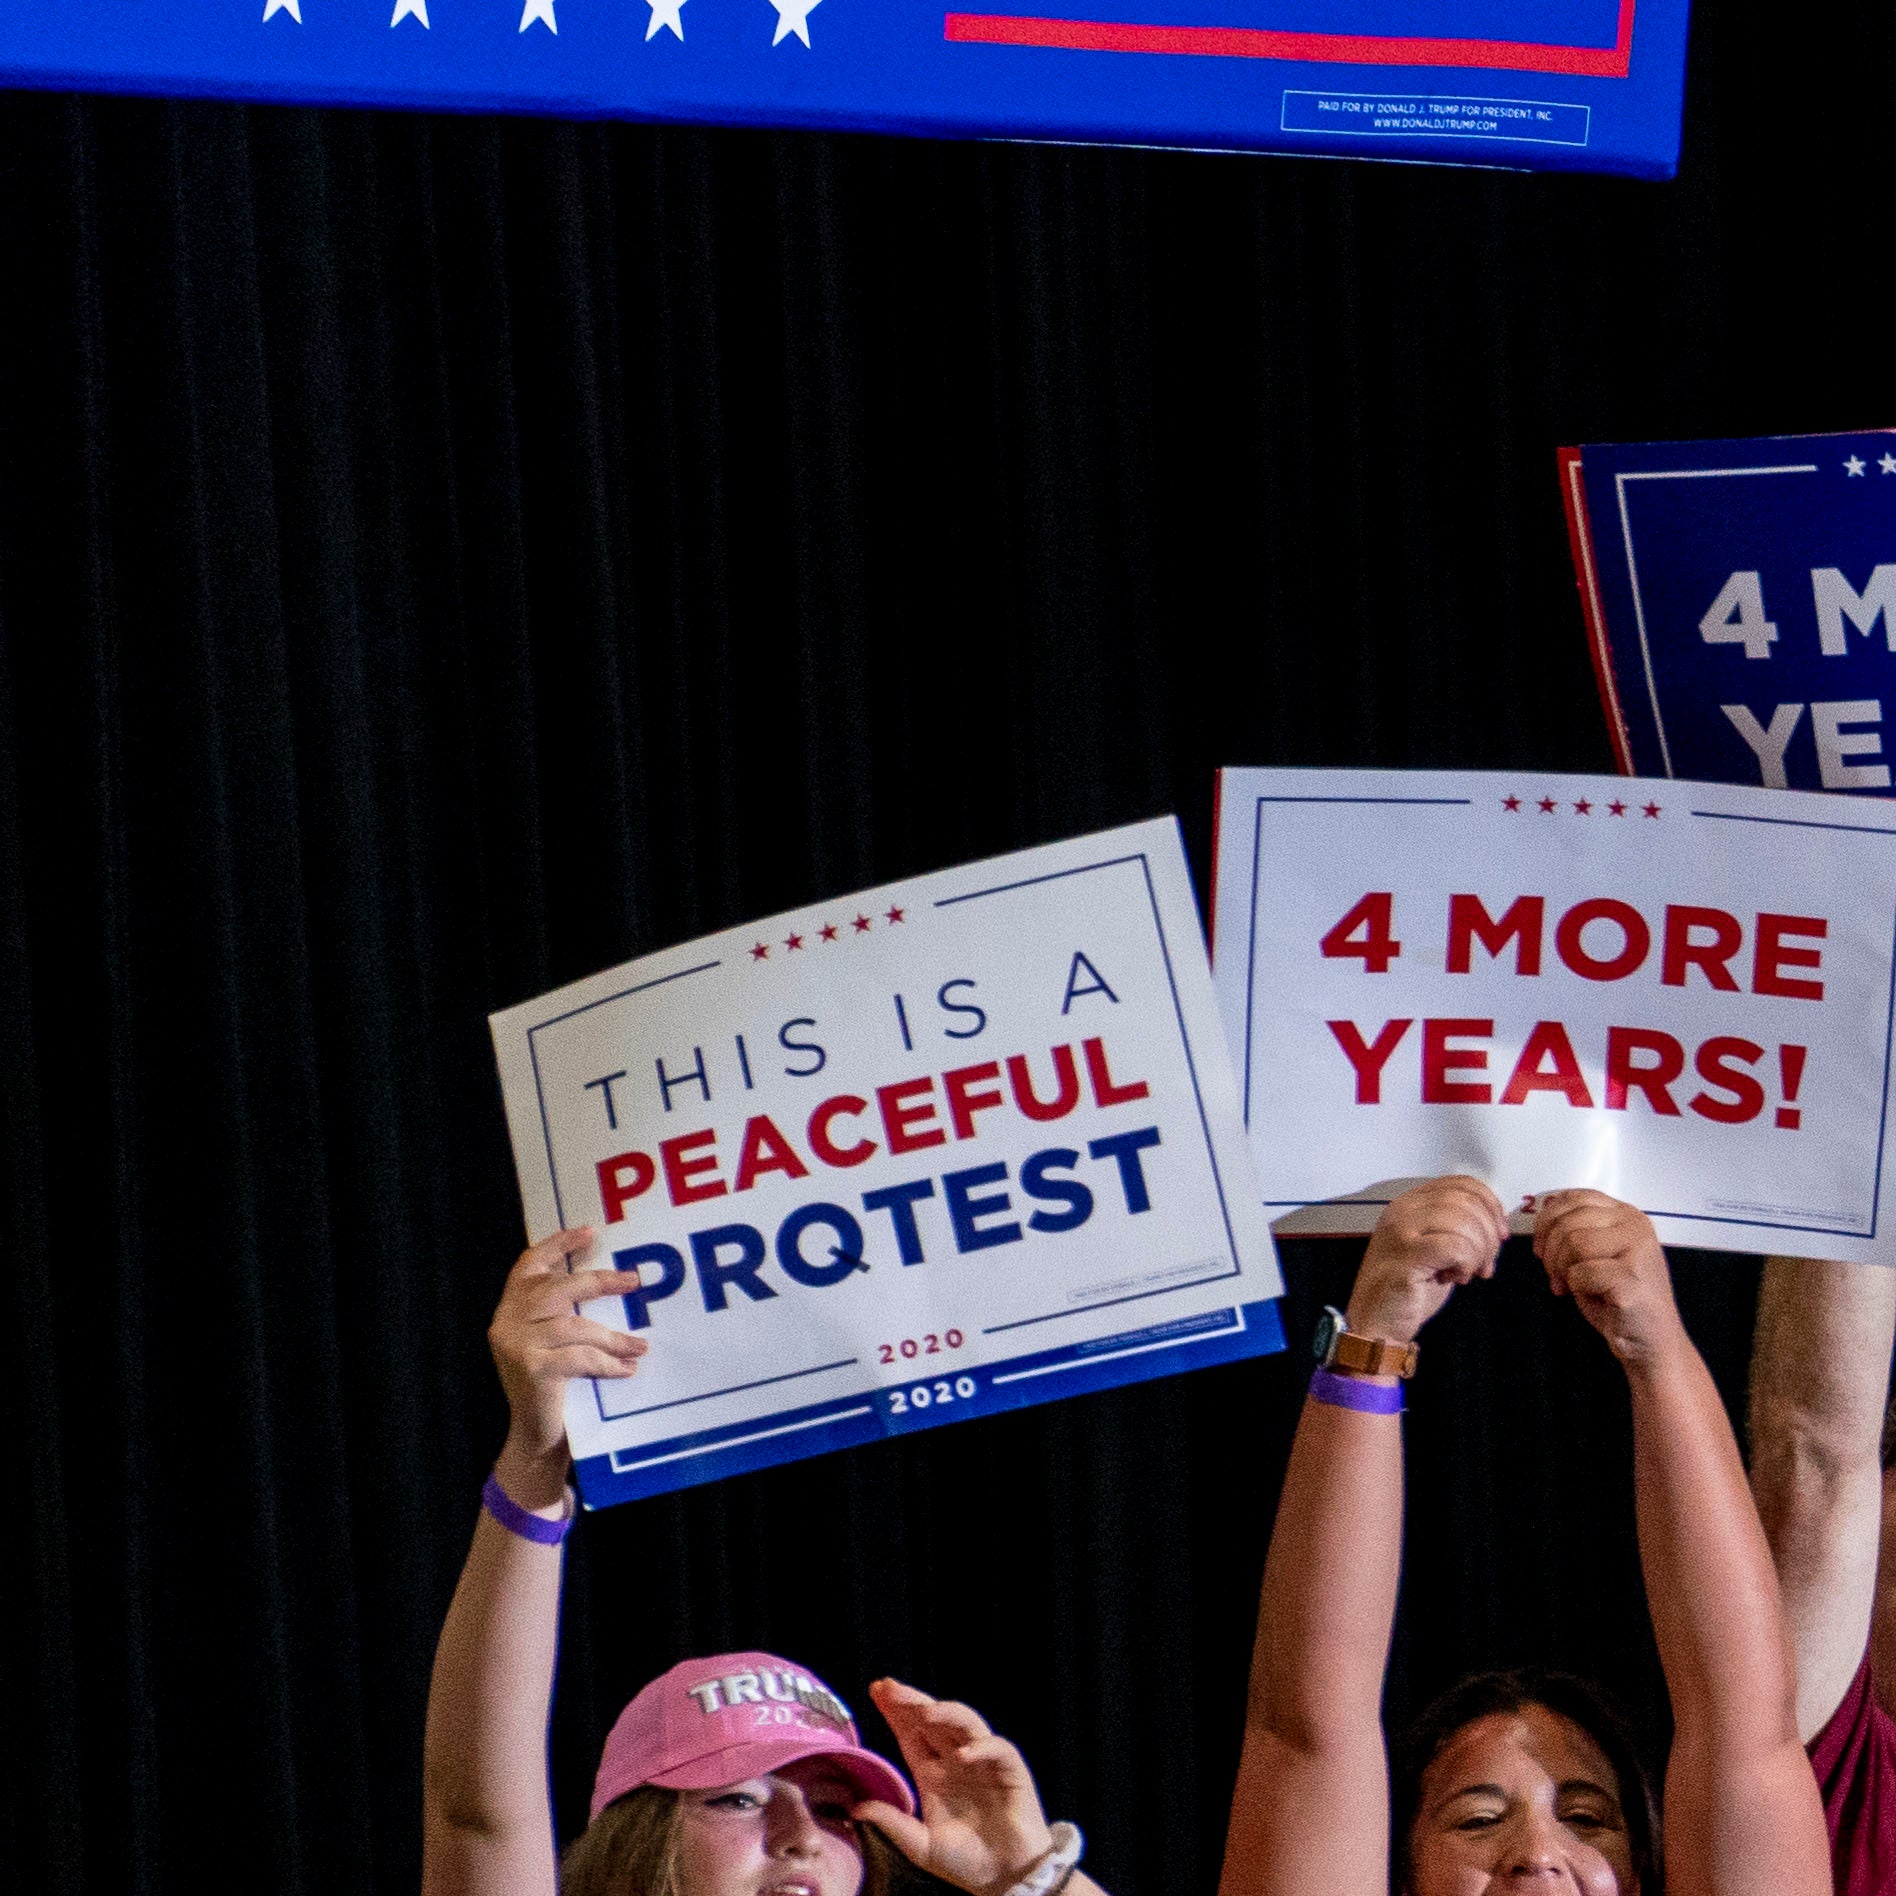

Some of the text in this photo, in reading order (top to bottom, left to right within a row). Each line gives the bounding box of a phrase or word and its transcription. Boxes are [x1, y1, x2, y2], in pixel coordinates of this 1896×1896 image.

[1317, 100, 1339, 112] PAID
[1342, 101, 1360, 113] FOR
[1363, 102, 1375, 114] BY
[1377, 103, 1417, 114] DONALD
[1429, 104, 1460, 115] TRUMP
[1462, 105, 1481, 116] FOR
[1373, 118, 1498, 132] WWW.DONALDJTRUMP.COM
[1698, 569, 1779, 660] 4
[1319, 890, 1829, 1001] 4 MORE
[584, 949, 1120, 1131] THIS IS A
[1325, 1018, 1808, 1131] YEARS!
[594, 1035, 1151, 1226] PEACEFUL
[878, 1327, 966, 1365] 2020
[888, 1375, 978, 1414] 2020
